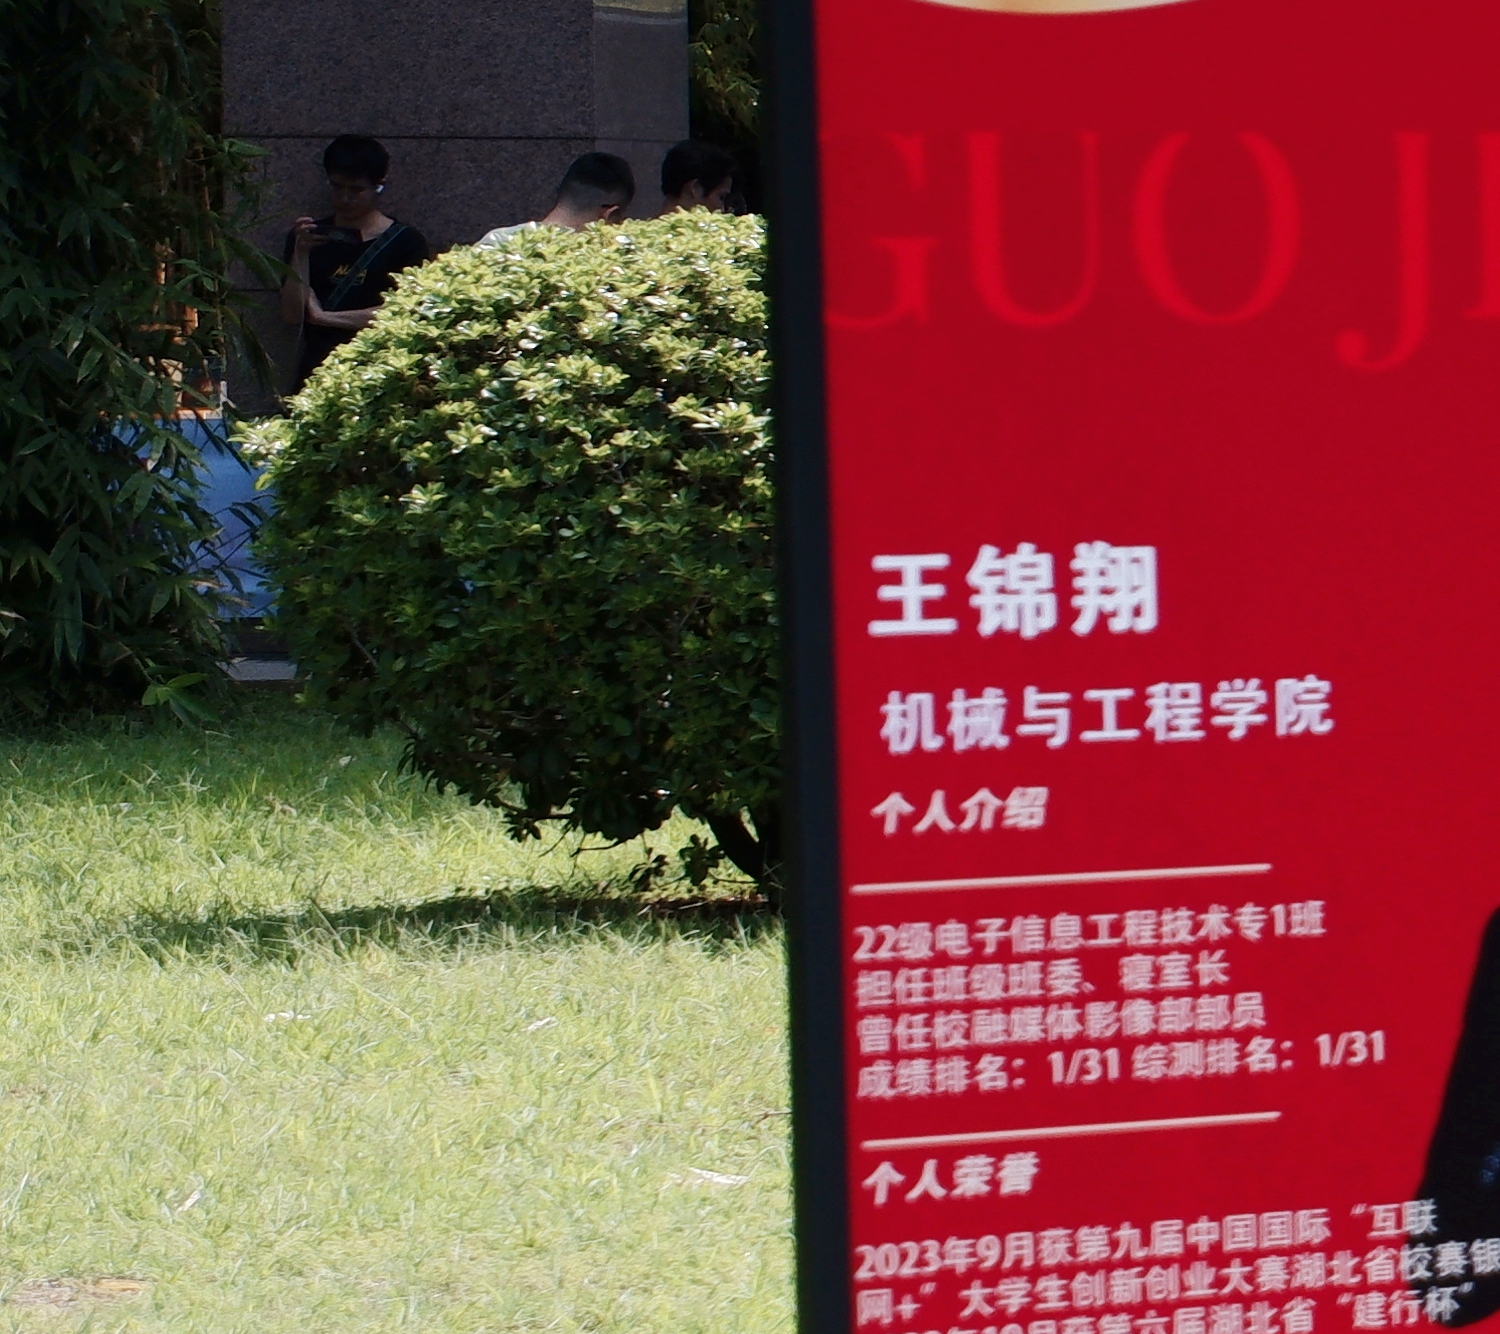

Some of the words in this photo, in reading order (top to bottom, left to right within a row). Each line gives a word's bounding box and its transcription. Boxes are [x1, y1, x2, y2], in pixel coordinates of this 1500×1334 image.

[867, 540, 1158, 640] 王锦翔
[879, 674, 1334, 755] 机械与工程学院
[869, 785, 1049, 837] 个人介绍
[862, 1152, 1041, 1207] 个人荣誉
